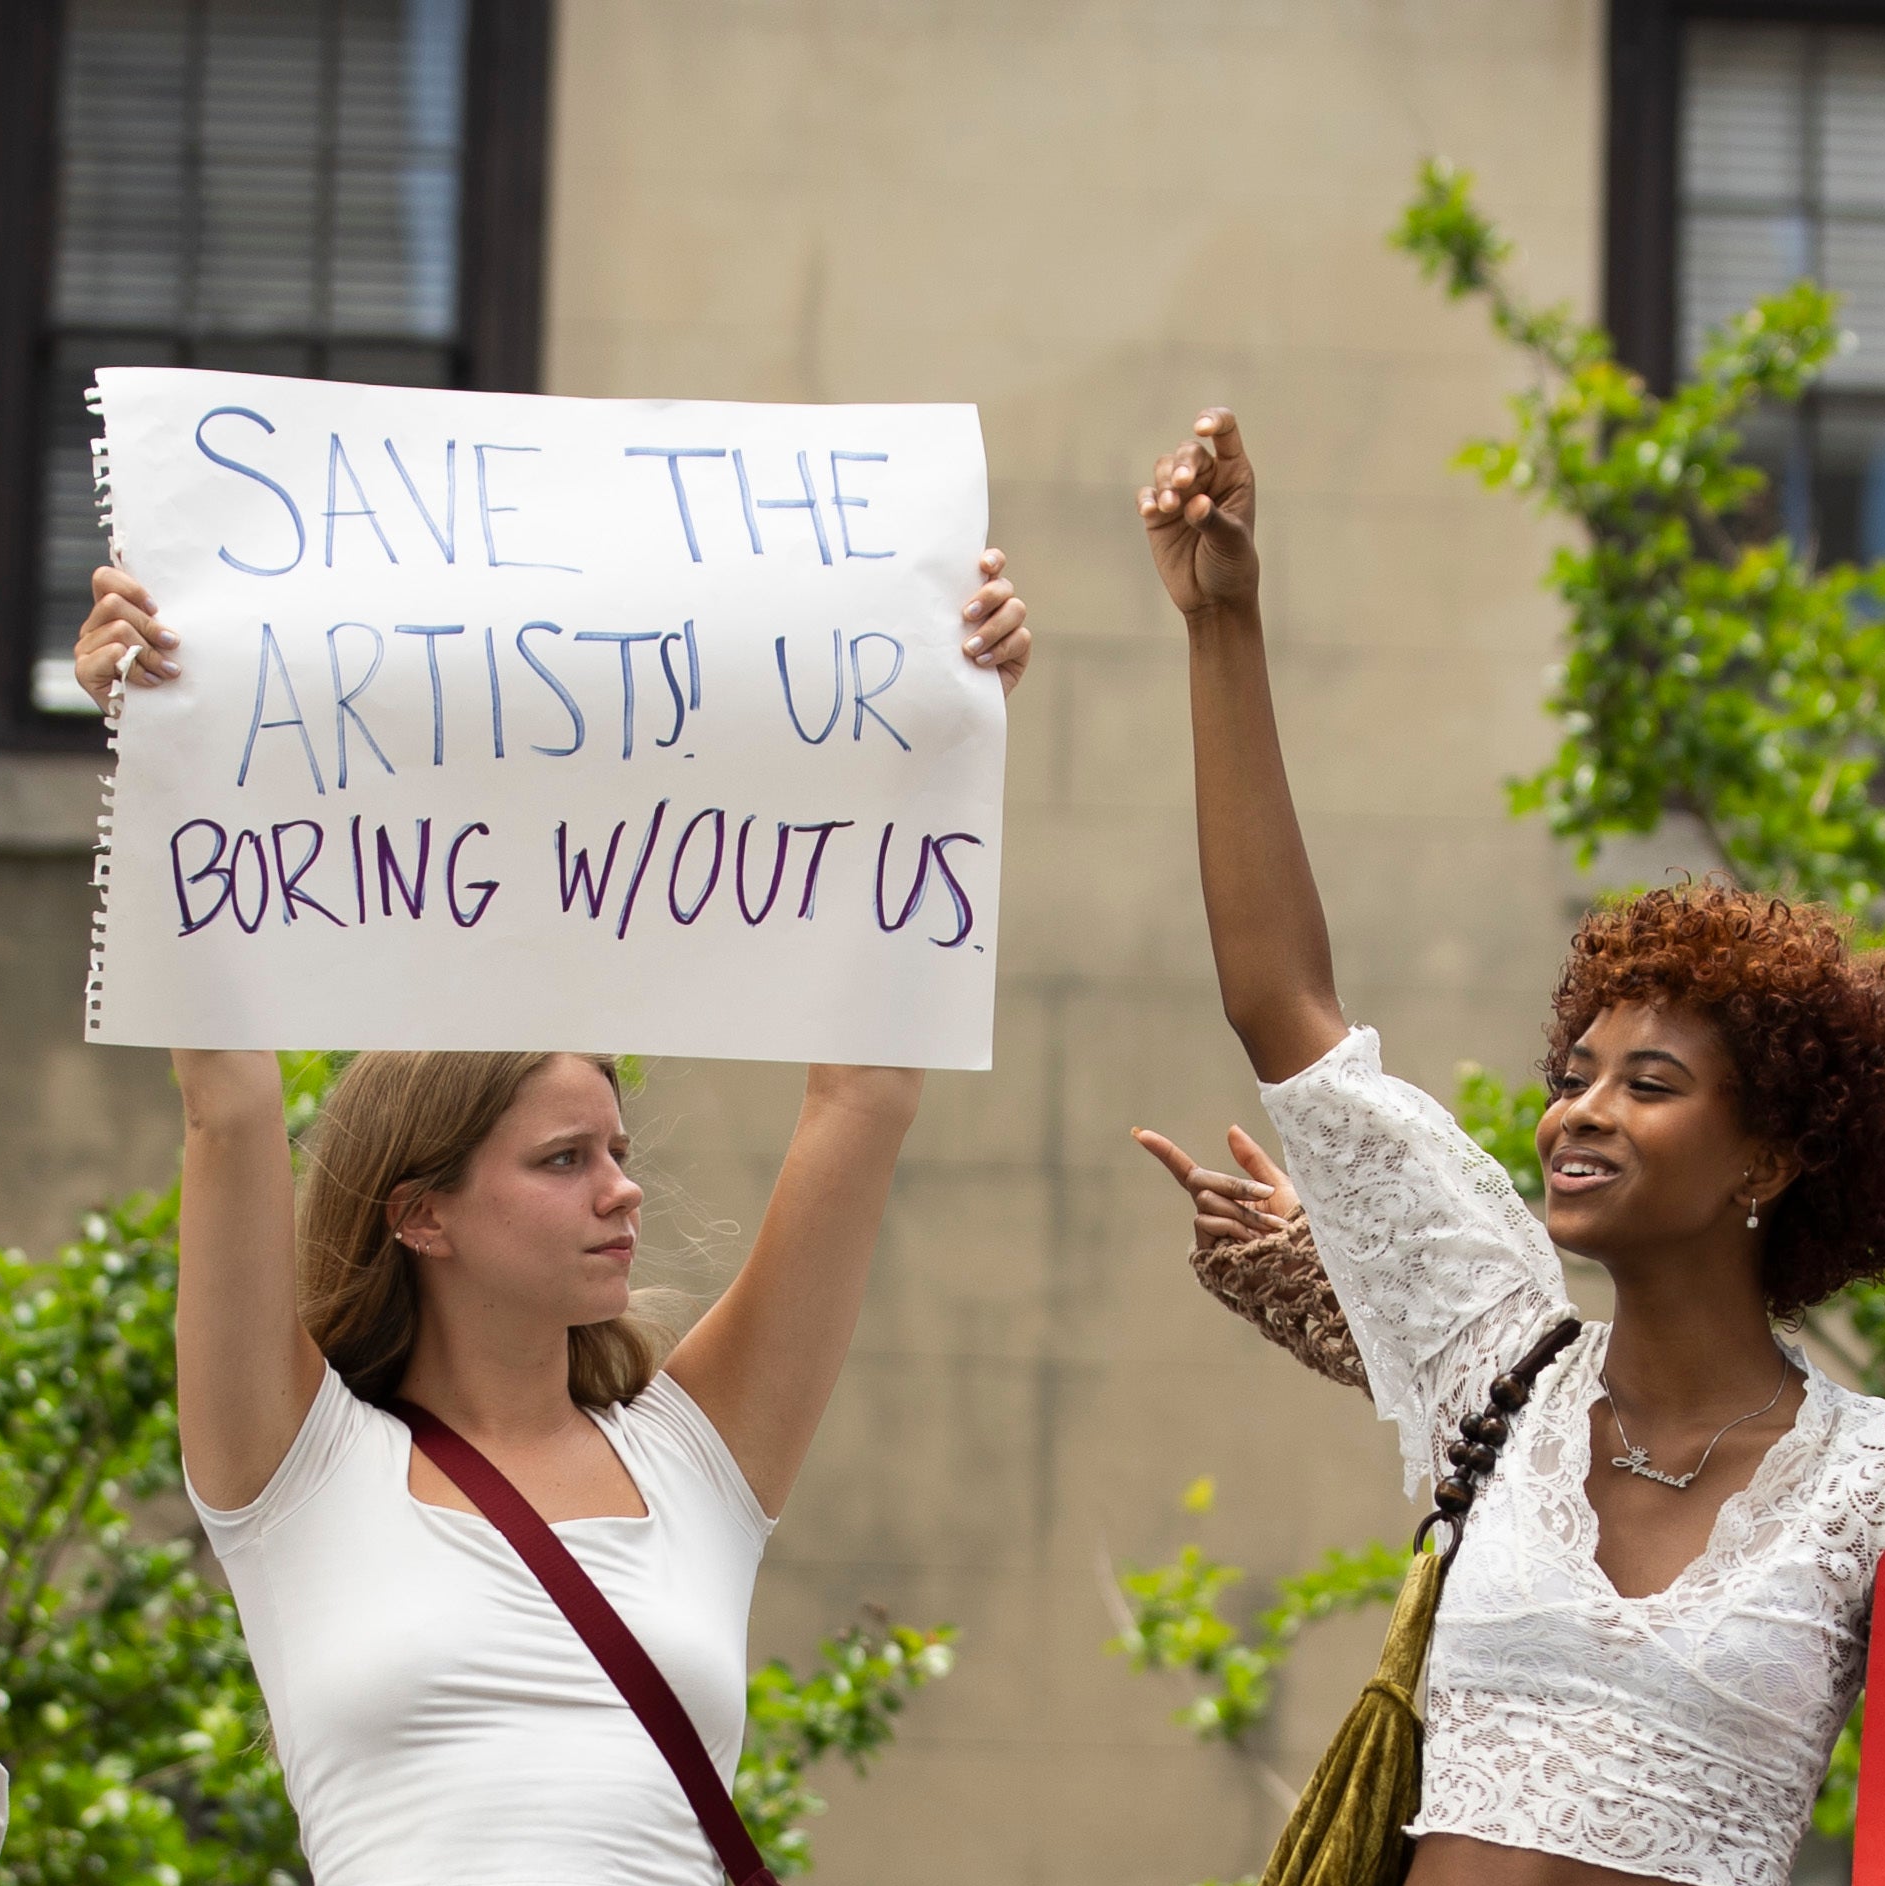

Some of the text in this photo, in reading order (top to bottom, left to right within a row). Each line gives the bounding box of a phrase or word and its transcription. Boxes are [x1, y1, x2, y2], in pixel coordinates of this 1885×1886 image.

[195, 405, 898, 576] SAVE THE
[237, 617, 912, 795] ARTISTS! UR
[169, 813, 501, 938] BORING
[552, 797, 855, 940] W/OUT
